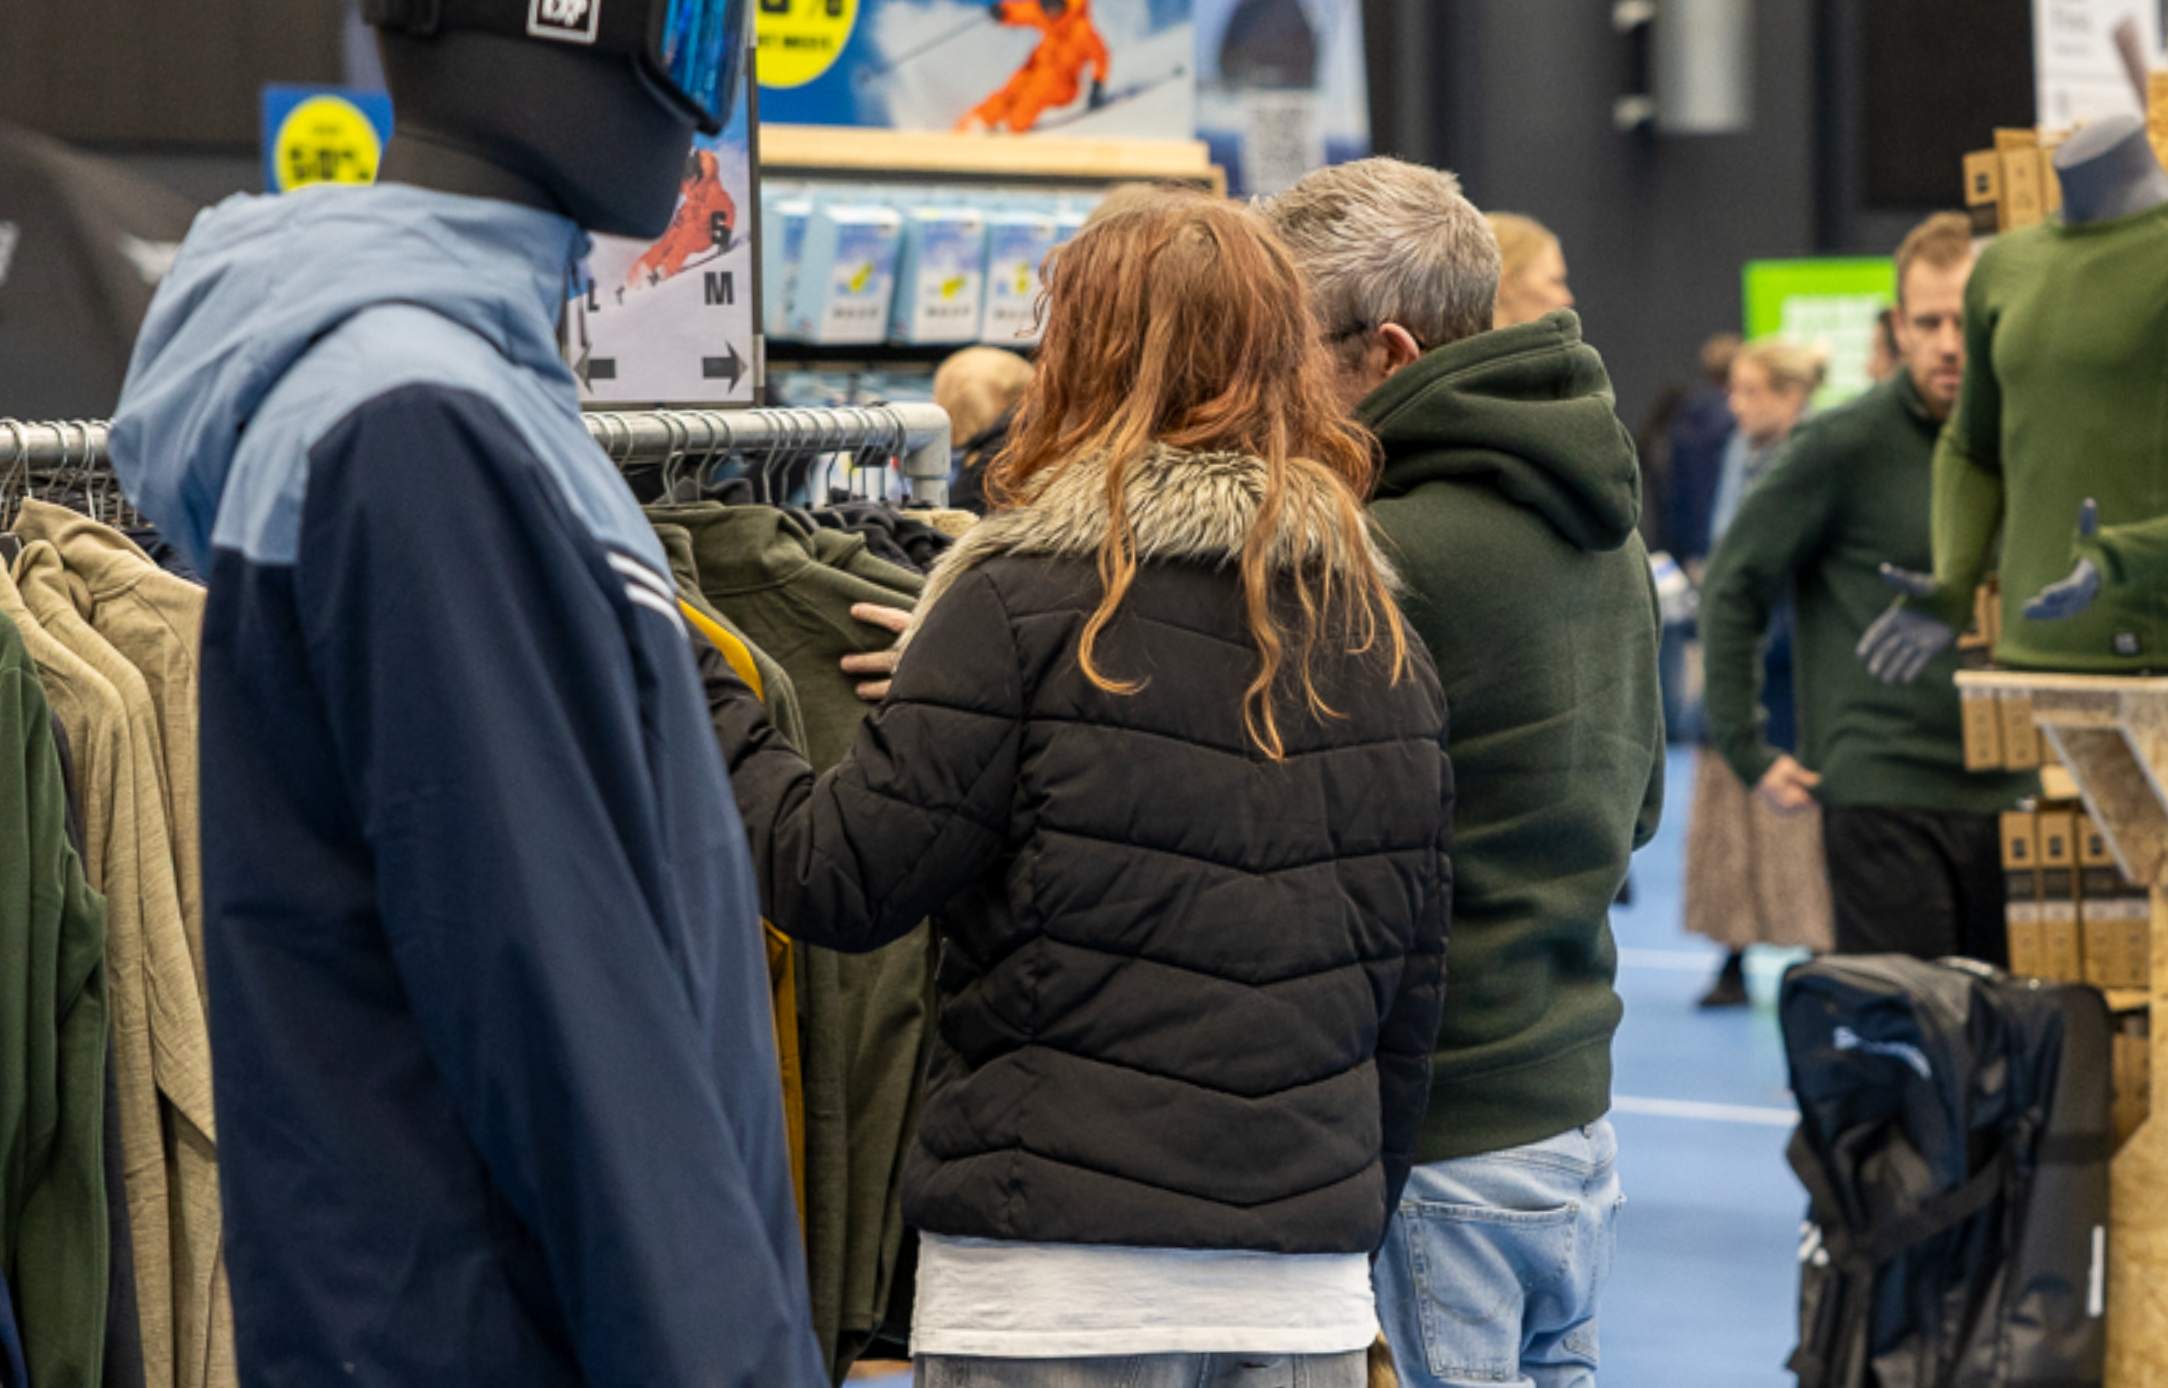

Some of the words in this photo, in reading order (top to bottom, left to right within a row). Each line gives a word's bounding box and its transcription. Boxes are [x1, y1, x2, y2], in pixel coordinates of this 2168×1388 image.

[710, 210, 731, 247] S
[587, 279, 600, 312] L
[704, 271, 734, 305] M
